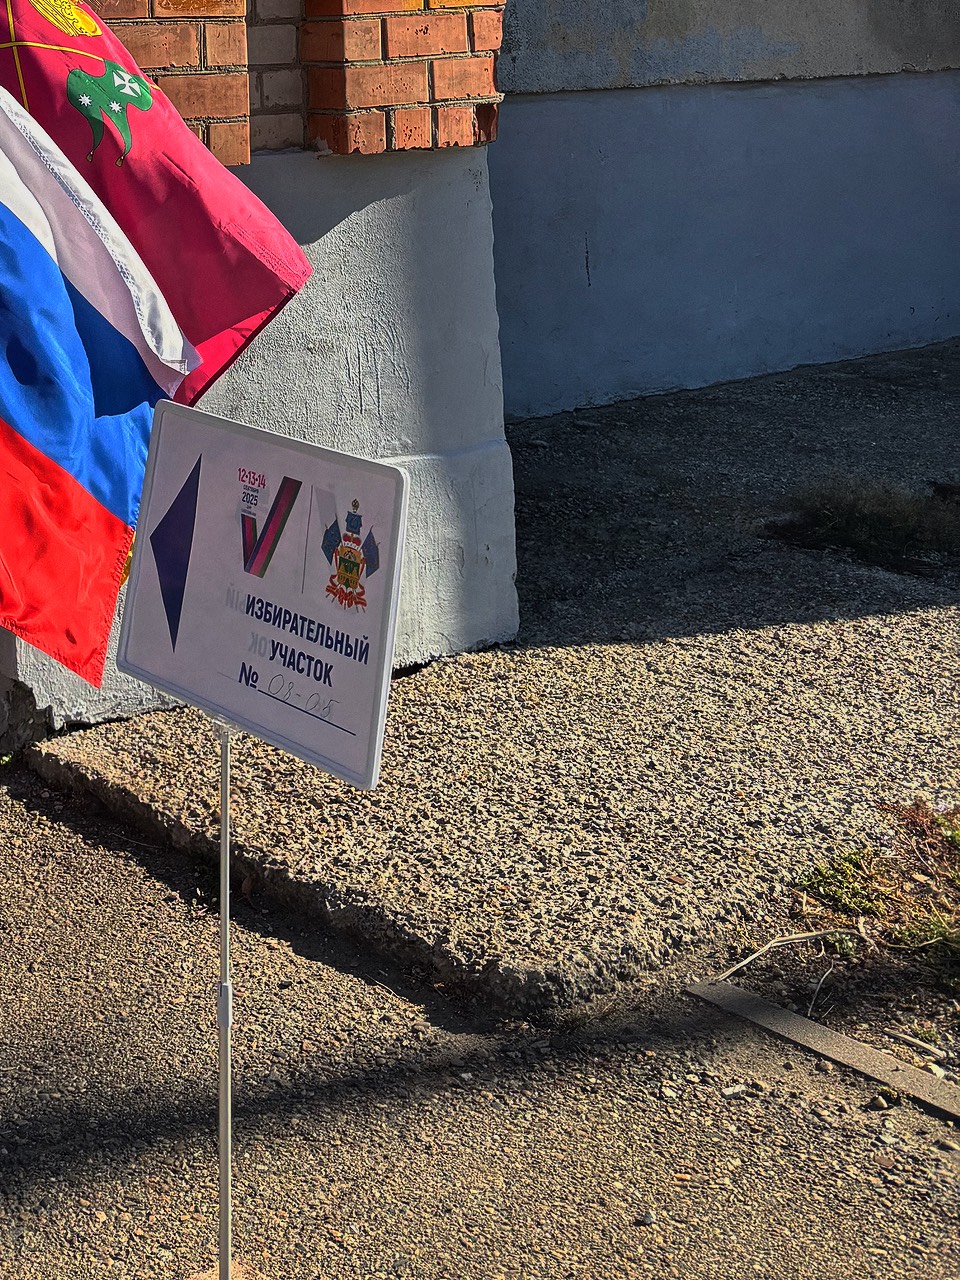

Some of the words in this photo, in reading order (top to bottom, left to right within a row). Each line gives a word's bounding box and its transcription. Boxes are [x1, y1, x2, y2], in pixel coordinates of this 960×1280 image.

[242, 491, 259, 507] 2025
[245, 593, 371, 665] ИЗБИРАТЕЛЬНЫЙ
[238, 661, 259, 689] №
[267, 673, 340, 718] 08-05
[269, 639, 334, 688] УЧАСТОК
